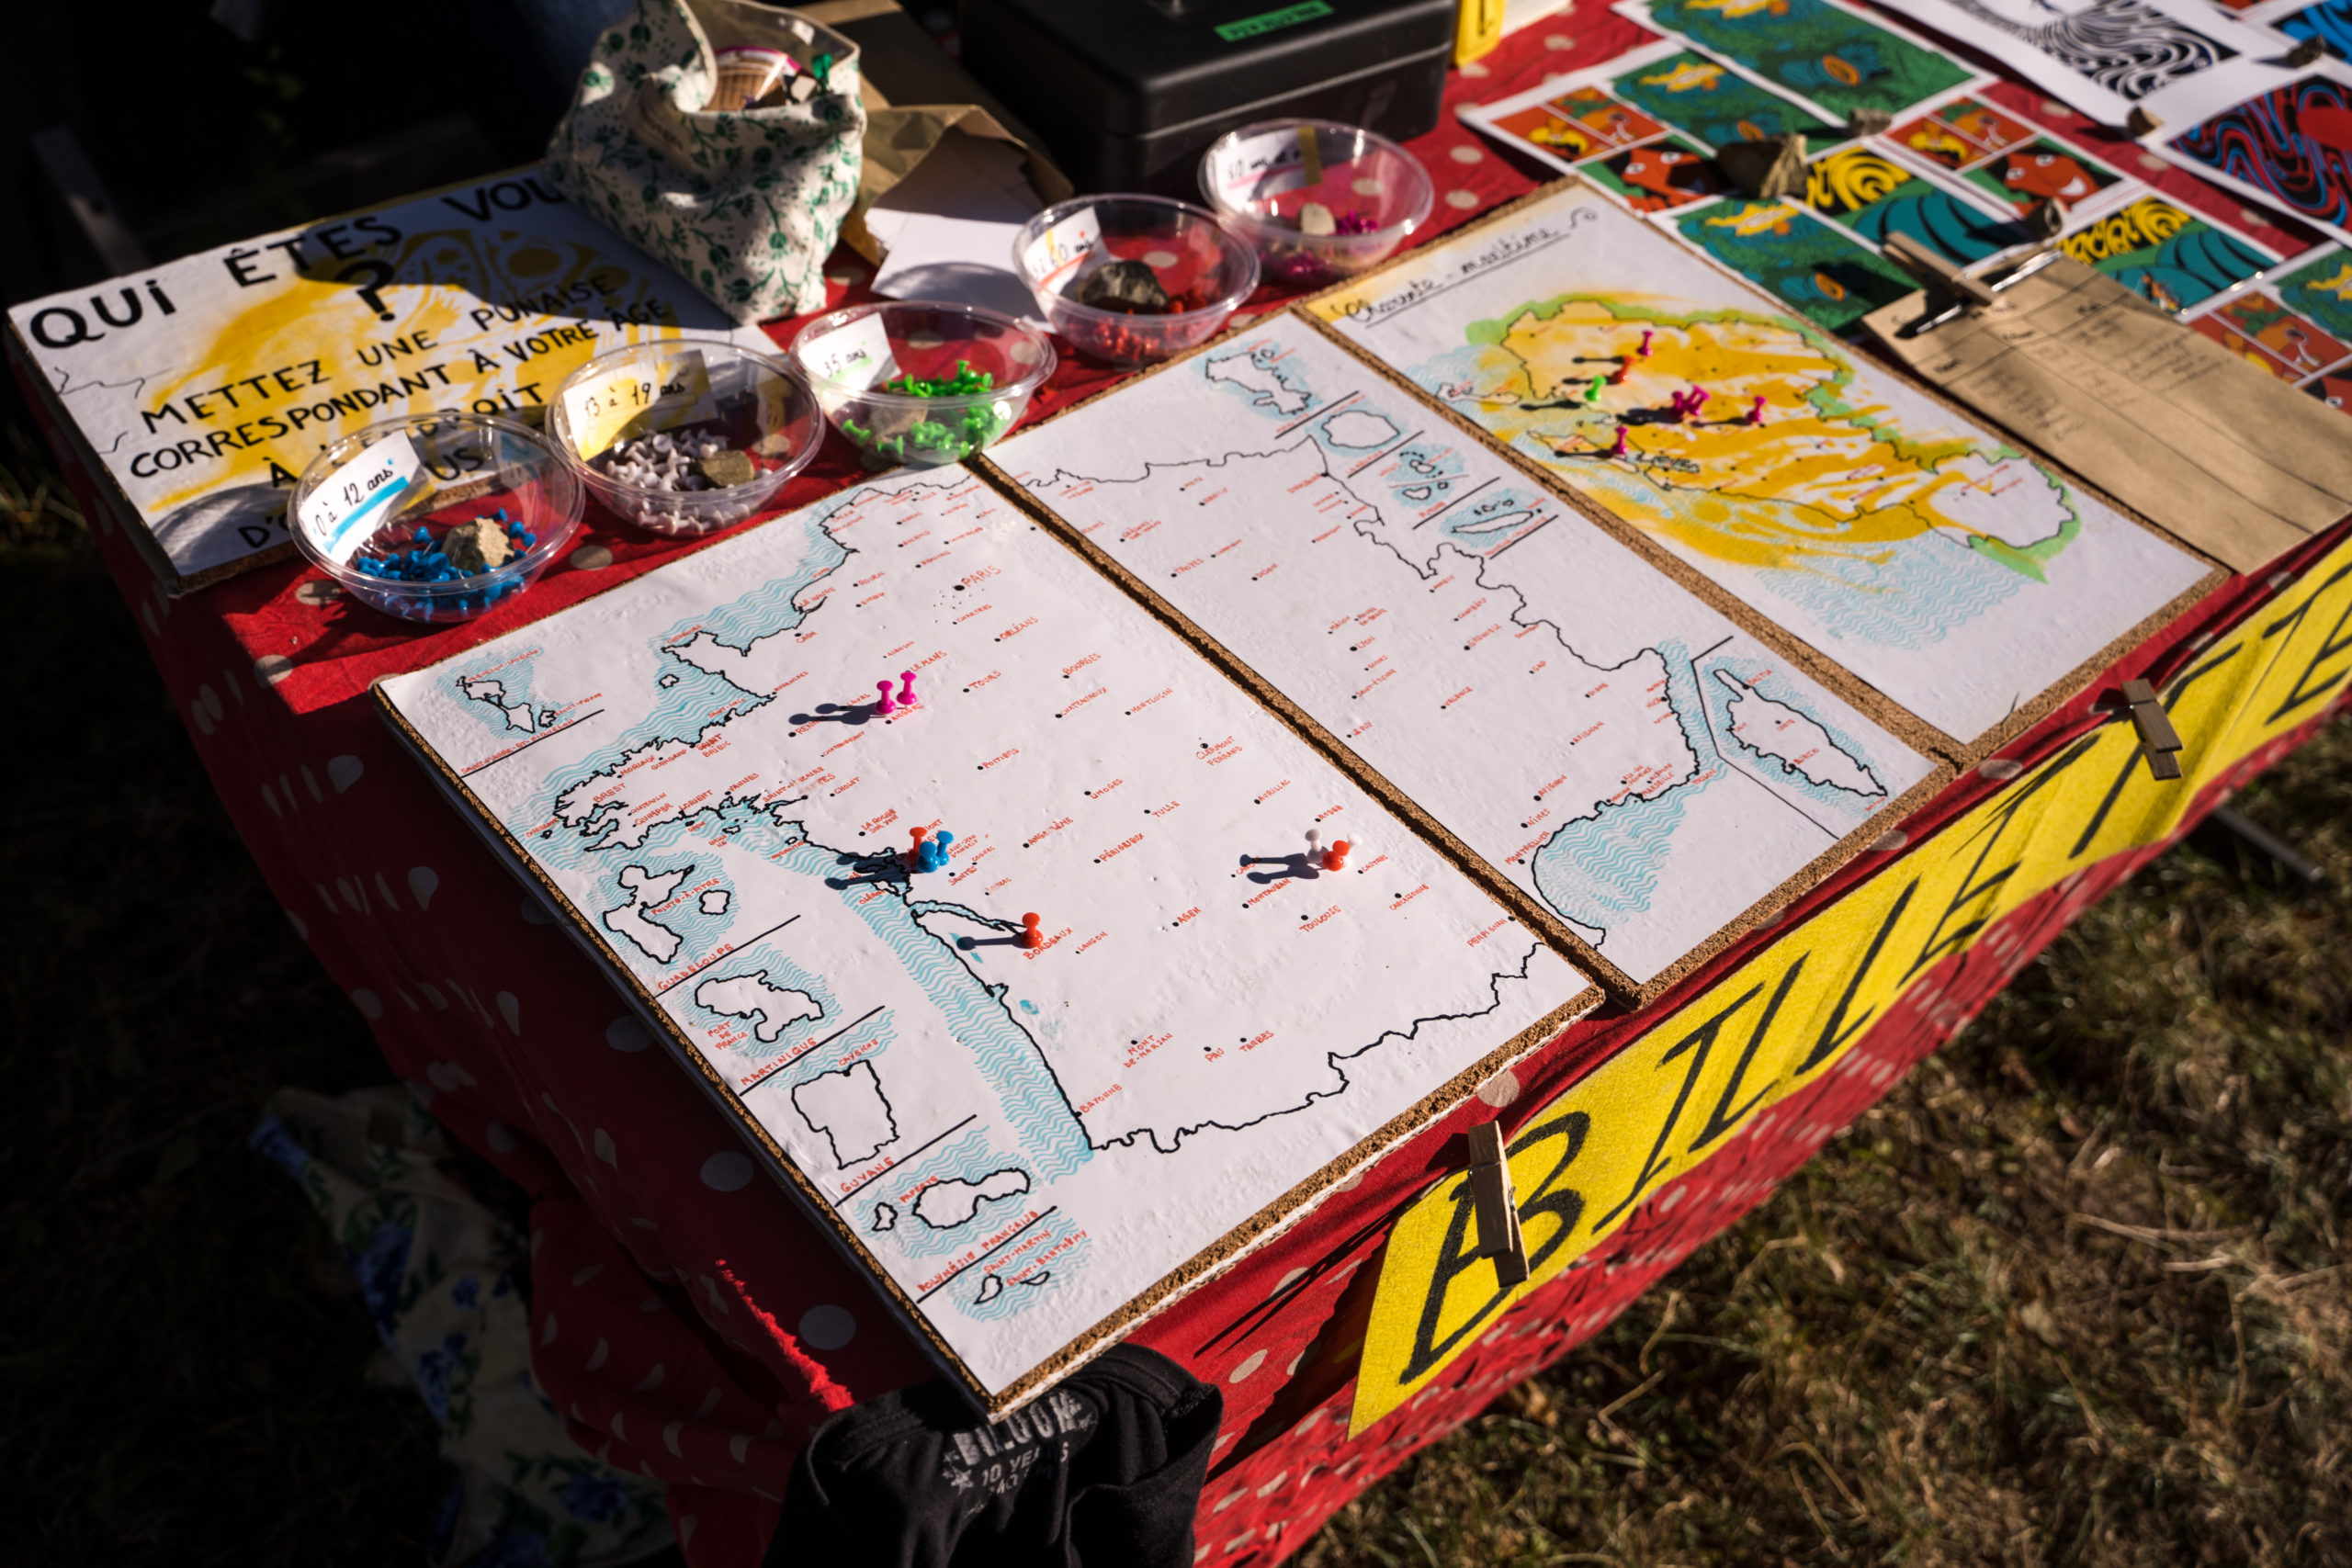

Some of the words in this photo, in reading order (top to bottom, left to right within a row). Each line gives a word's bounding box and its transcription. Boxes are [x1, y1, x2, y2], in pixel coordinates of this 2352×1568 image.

[223, 216, 402, 288] ÊTES
[441, 175, 568, 222] VOU
[335, 260, 395, 321] ?
[140, 360, 331, 435] METTEZ
[357, 330, 438, 367] UNE
[469, 275, 617, 331] PUNAISE
[130, 364, 452, 479] CORRESPONDANT
[469, 347, 502, 374] À
[503, 326, 599, 365] VOTRE
[631, 382, 651, 406] 19
[660, 381, 685, 397] ans
[344, 483, 364, 506] 12
[368, 468, 393, 491] ans
[961, 566, 1001, 587] PARIS
[1000, 617, 1038, 639] ORLÉANS
[1062, 654, 1101, 675] BOURGES
[968, 671, 1001, 689] TOURS
[1196, 736, 1235, 759] CLERMONT
[982, 749, 1019, 769] POITIERS
[593, 783, 625, 803] BREST
[728, 773, 759, 792] VANNES
[834, 777, 859, 794] CHOLET
[1258, 780, 1290, 801] AURILLAC
[678, 790, 713, 810] LORIENT
[1152, 801, 1180, 818] TULLE
[635, 803, 673, 825] QUIMPER
[924, 819, 941, 830] IORT
[1177, 907, 1201, 923] AGEN
[1299, 905, 1341, 931] TOULOUSE
[1023, 928, 1071, 960] BORDEAUX
[1079, 932, 1108, 951] LANGON
[658, 943, 734, 990] GUADELOUPE
[707, 1021, 729, 1037] FORT
[719, 1031, 730, 1039] DE
[715, 1032, 747, 1050] FRANCE
[1128, 1035, 1159, 1055] MONT
[1239, 1031, 1273, 1051] TARBES
[741, 1038, 816, 1086] MARTINIQUE
[1205, 1048, 1224, 1062] PAU
[1080, 1084, 1122, 1112] BAYONNE
[841, 1156, 894, 1192] GUYANE
[984, 1230, 1051, 1275] SAINT-MARTIN
